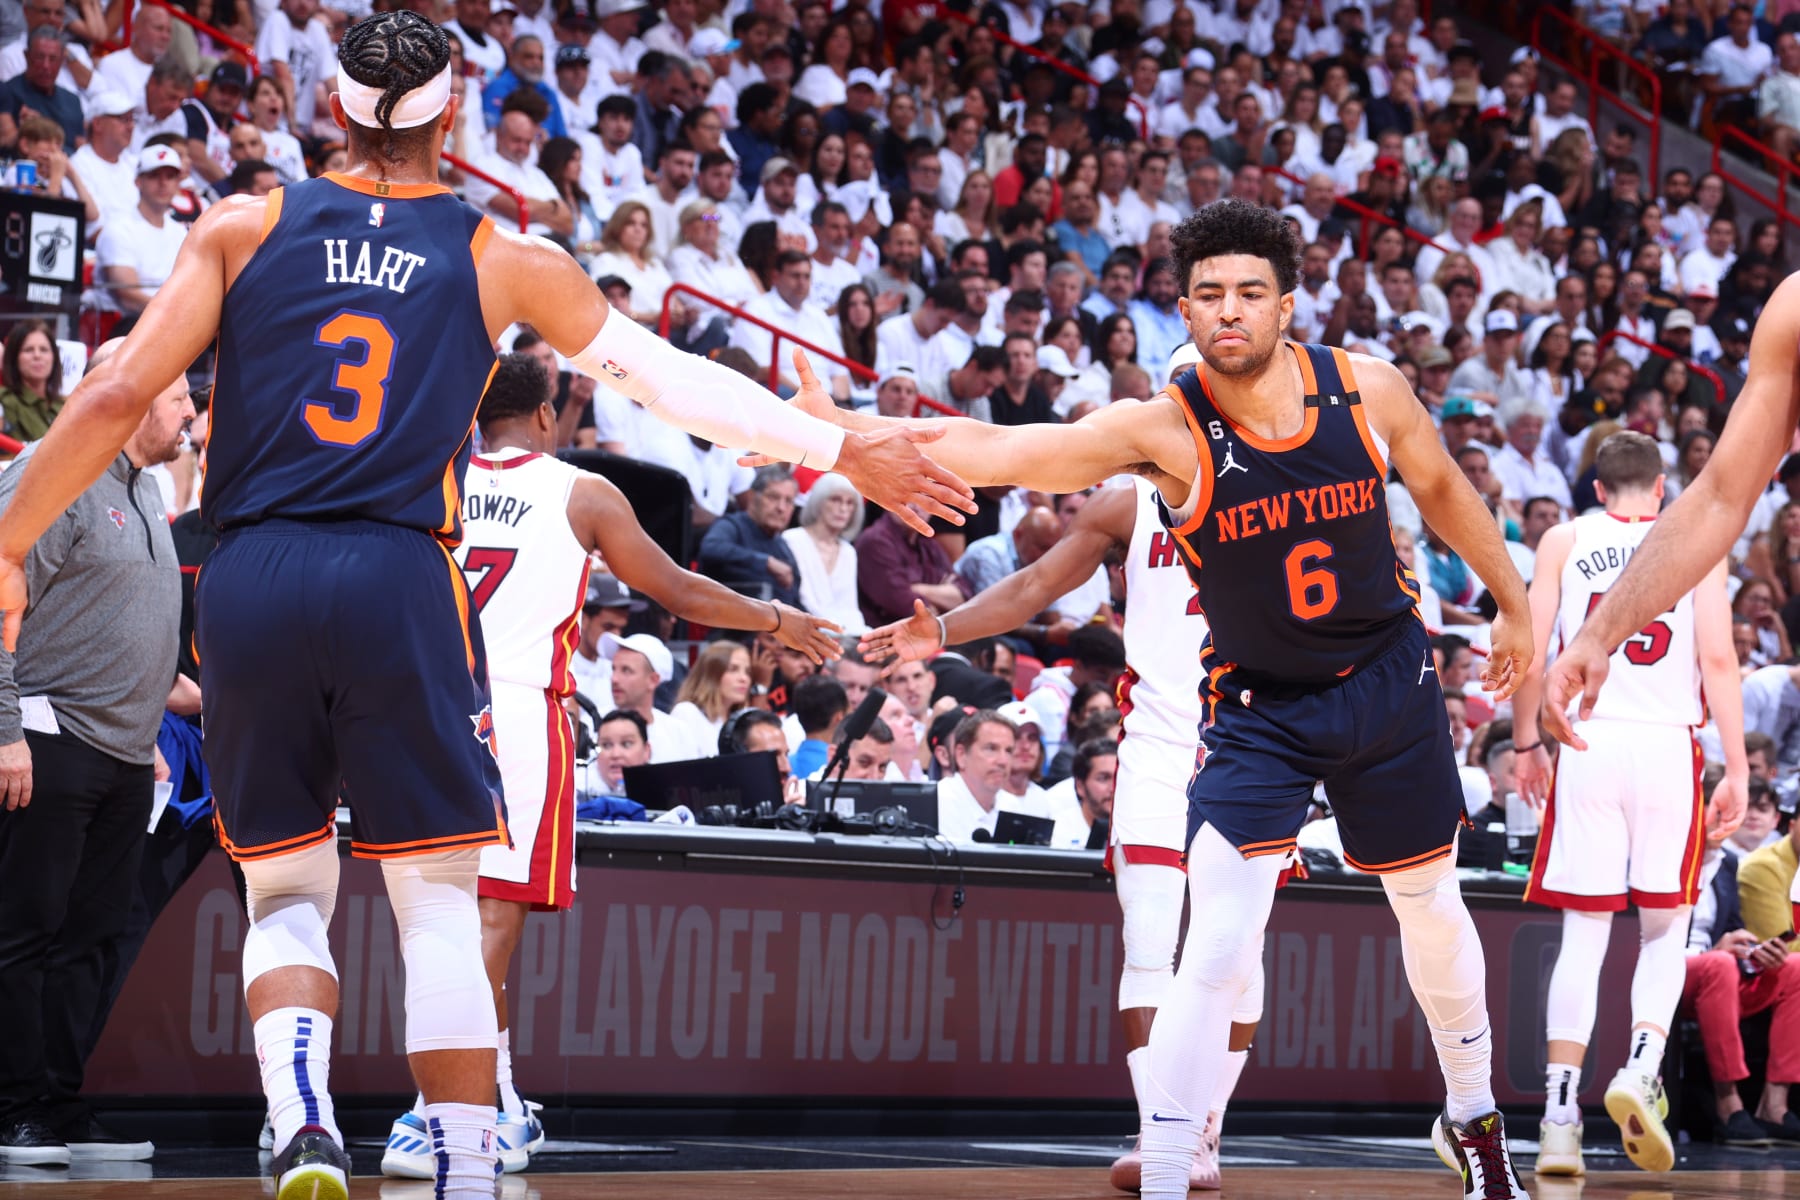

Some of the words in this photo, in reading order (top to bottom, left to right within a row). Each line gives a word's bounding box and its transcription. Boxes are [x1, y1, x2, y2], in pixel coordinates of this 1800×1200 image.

[324, 239, 426, 294] HART
[299, 307, 399, 450] 3
[1207, 419, 1225, 440] 6
[462, 493, 533, 528] OWRY
[1215, 491, 1291, 543] NEW
[1295, 477, 1377, 524] YORK
[463, 546, 519, 616] 7
[1282, 537, 1341, 623] 6
[516, 901, 784, 1060] PLAYOFF
[794, 911, 964, 1064] MODE
[976, 919, 1115, 1065] WITH
